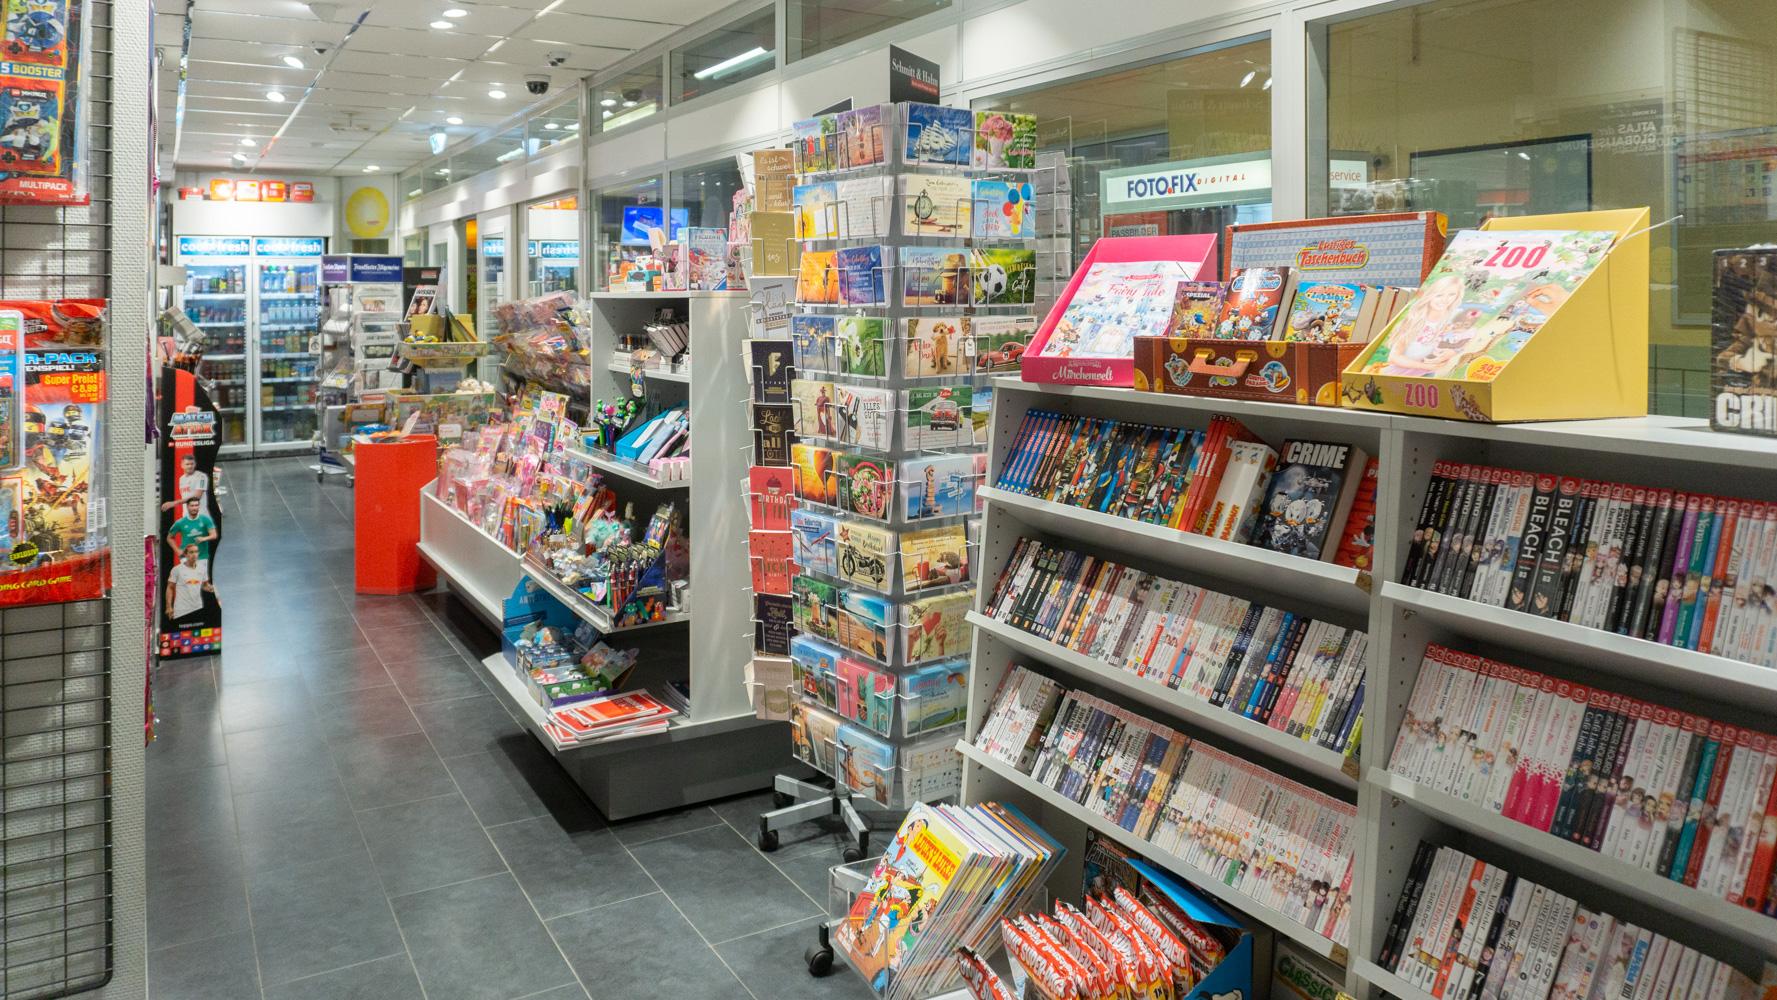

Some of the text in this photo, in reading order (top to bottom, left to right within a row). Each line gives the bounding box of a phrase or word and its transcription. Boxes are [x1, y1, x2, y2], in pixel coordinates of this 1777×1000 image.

[12, 64, 63, 78] BOOSTER
[891, 58, 915, 78] Schmitt
[916, 69, 922, 81] &
[19, 180, 68, 191] MULTIPACK
[1197, 173, 1247, 186] DIGITAL
[1330, 170, 1362, 182] service
[1300, 250, 1366, 267] Taschenbuch
[1484, 245, 1549, 269] ZOO
[45, 373, 97, 385] Super Preis!
[1404, 382, 1439, 409] ZOO
[172, 412, 214, 424] MATCH
[175, 440, 215, 448] BUNDESLIGA
[1287, 441, 1349, 469] CRIME
[1521, 495, 1550, 560] BLEACH
[1545, 498, 1573, 564] BLEACH
[20, 575, 73, 588] CARD GAME
[914, 833, 957, 880] LUCKY LUKE
[1526, 899, 1554, 950] OVERLORD
[1536, 901, 1565, 954] OVERLORD
[1547, 906, 1576, 958] OVERLORD
